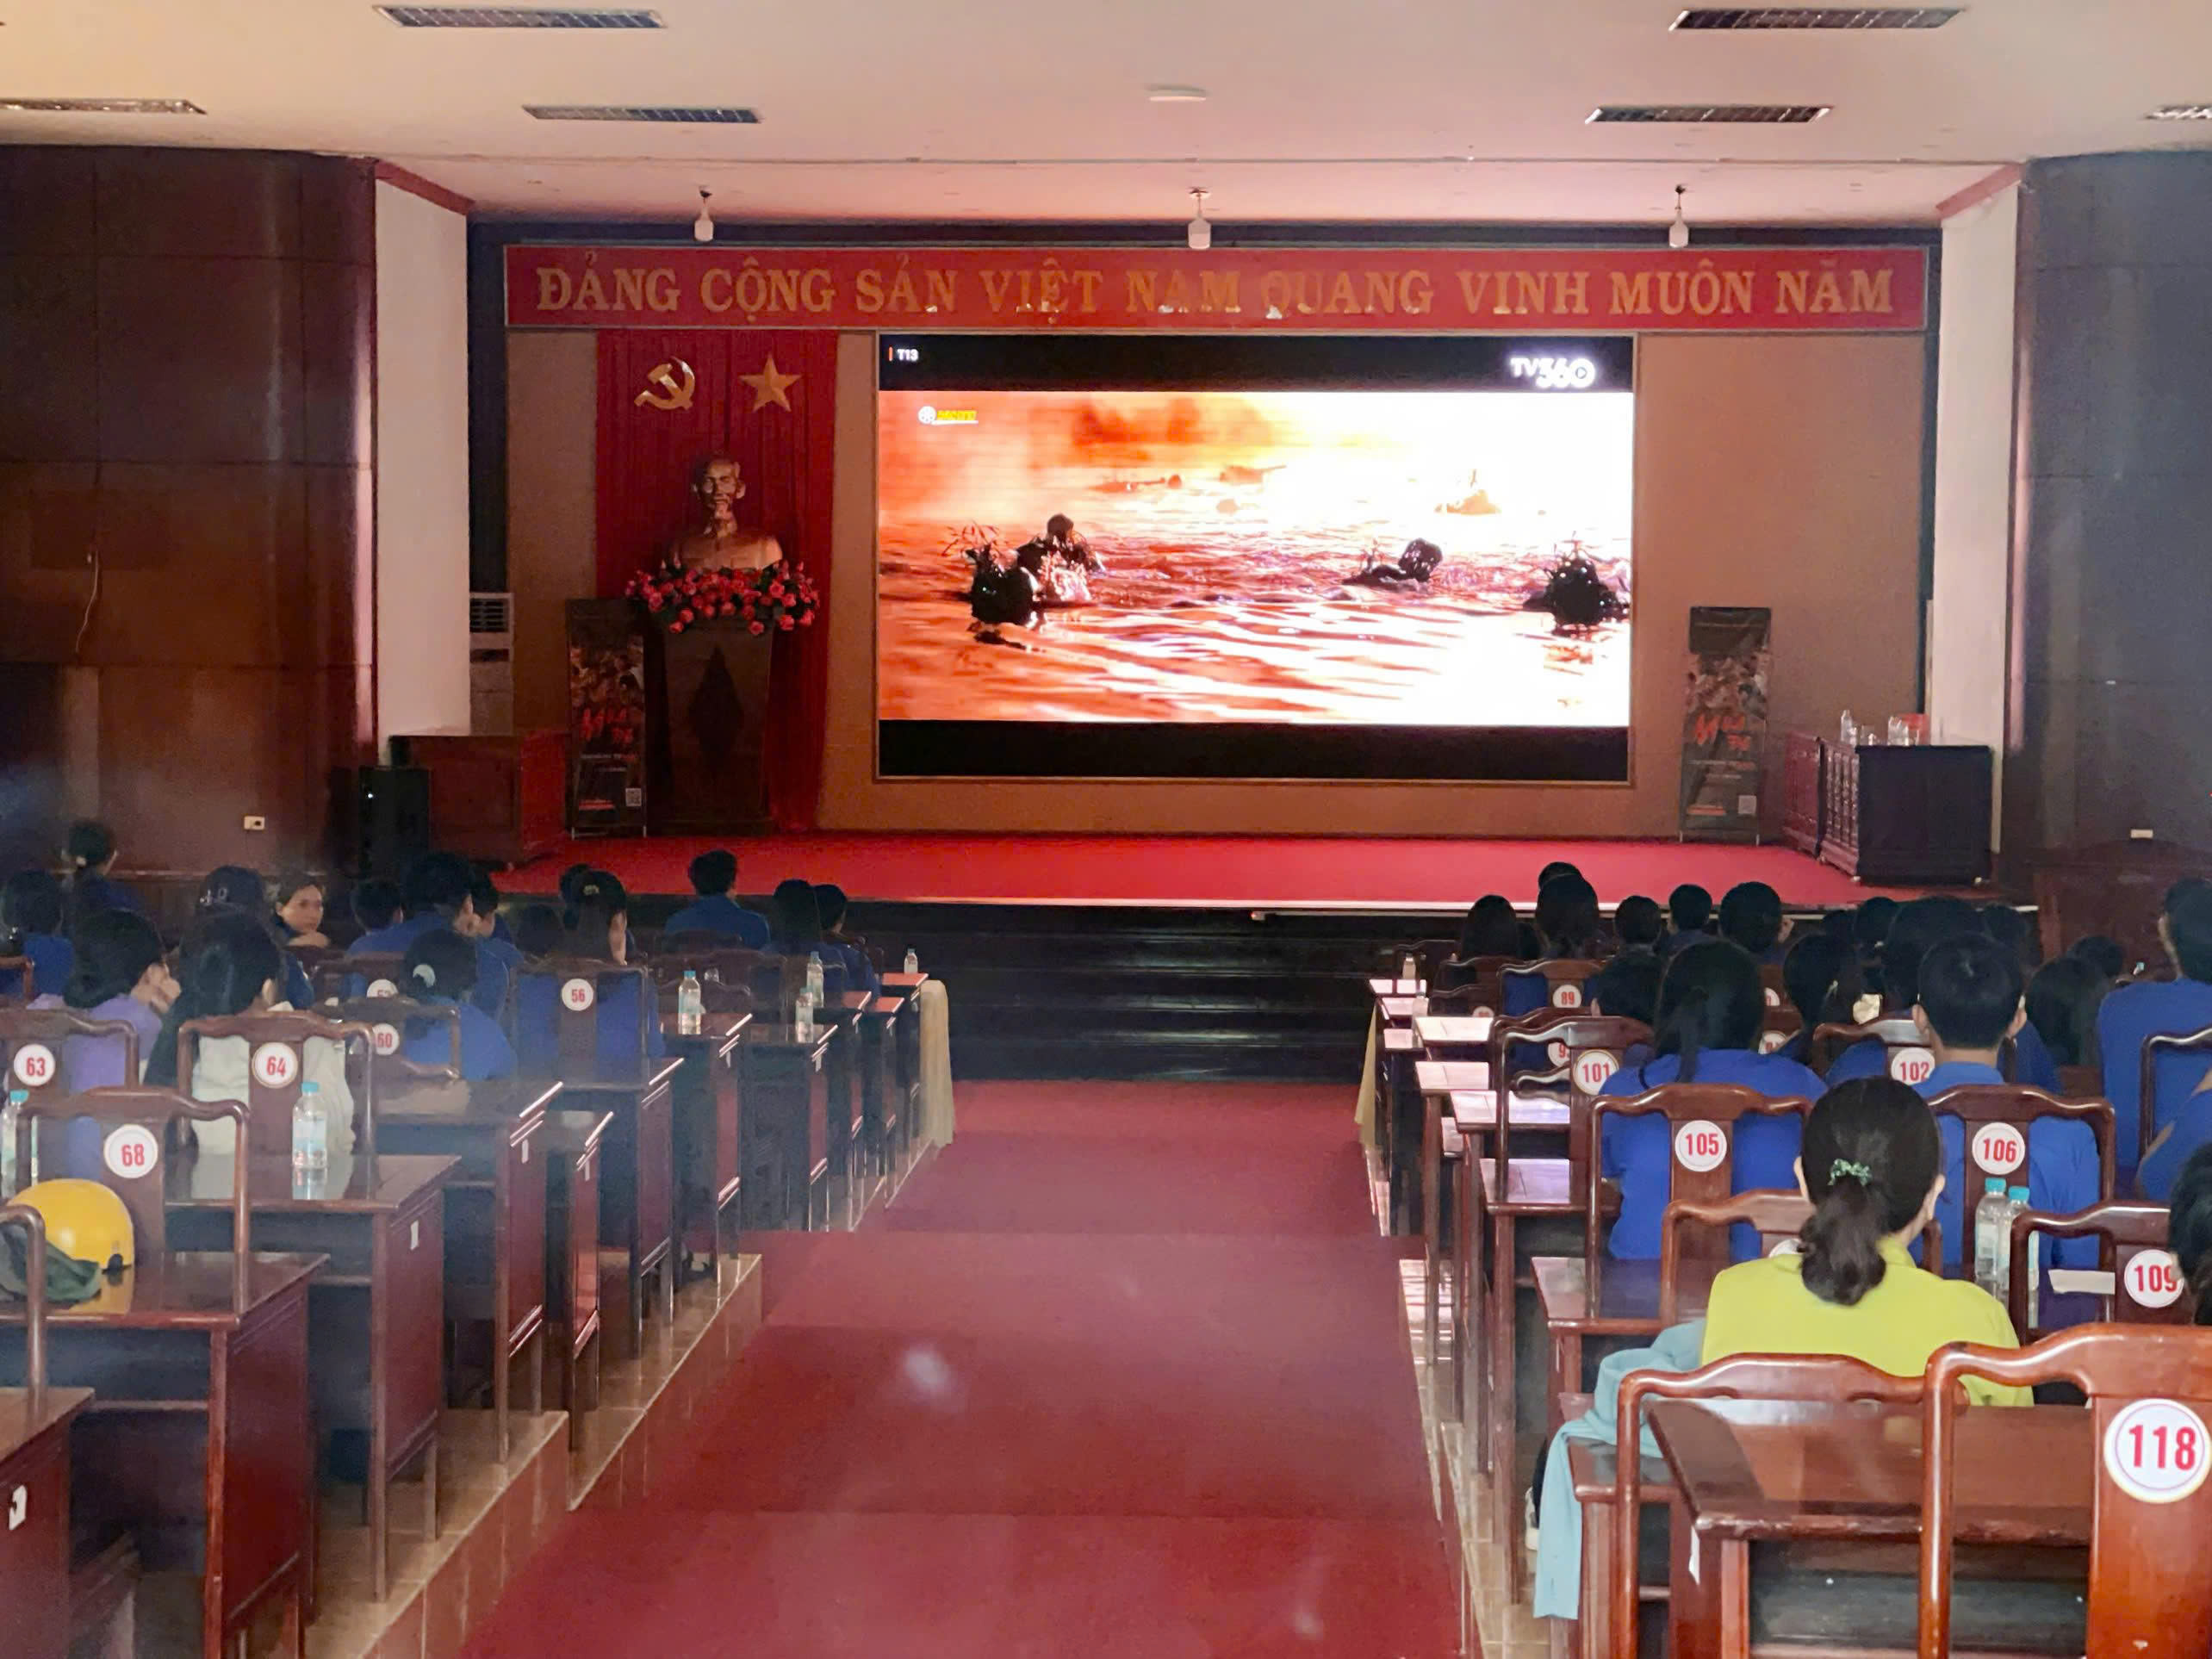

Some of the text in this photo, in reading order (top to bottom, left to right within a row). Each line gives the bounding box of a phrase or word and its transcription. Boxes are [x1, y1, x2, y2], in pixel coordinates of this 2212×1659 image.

[536, 250, 1893, 324] ĐẢNG CỘNG SẢN VIỆT NAM QUANG VINH MUÔN NĂM
[570, 985, 586, 1005] 56
[1561, 991, 1575, 1006] 89
[376, 1032, 393, 1048] 60
[26, 1057, 46, 1077] 63
[266, 1057, 287, 1077] 64
[1581, 1062, 1610, 1083] 101
[1899, 1060, 1930, 1083] 102
[121, 1144, 145, 1167] 68
[1685, 1133, 1720, 1157] 105
[1981, 1138, 2017, 1164] 106
[2134, 1264, 2178, 1293] 109
[2128, 1423, 2196, 1471] 118
